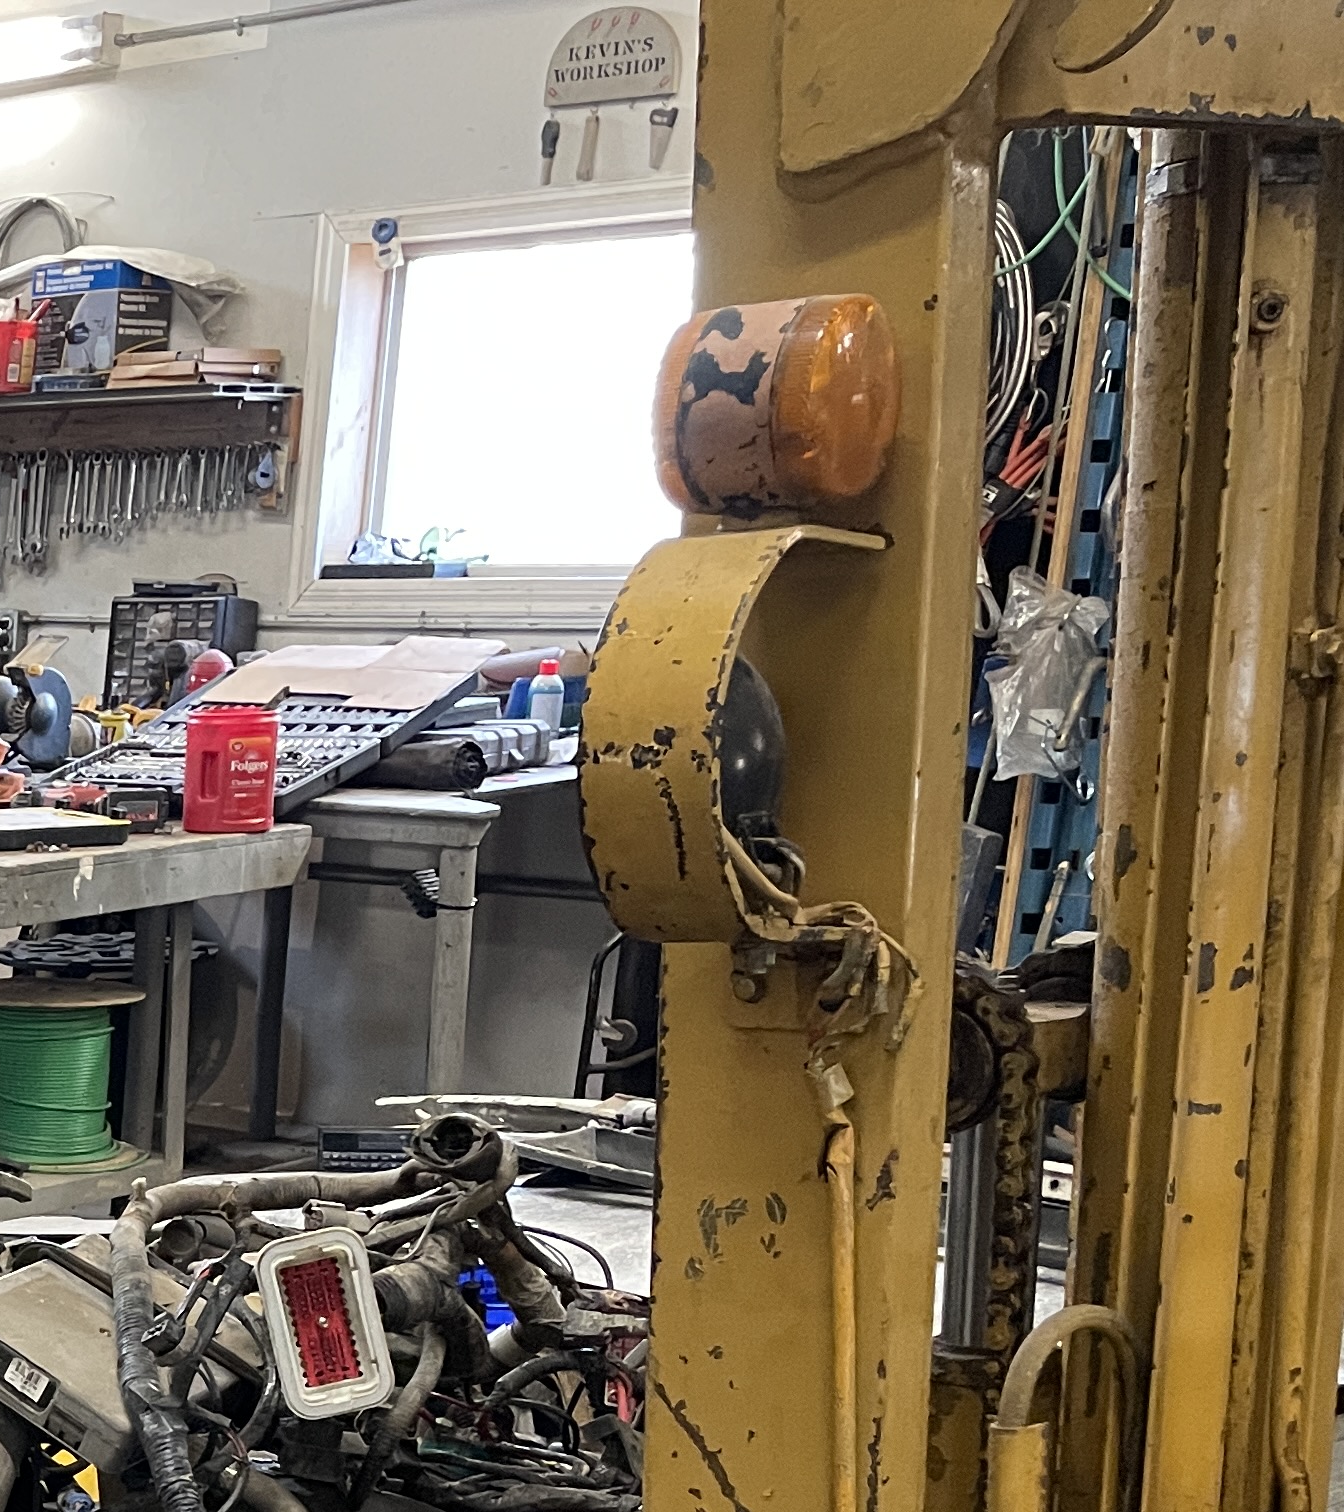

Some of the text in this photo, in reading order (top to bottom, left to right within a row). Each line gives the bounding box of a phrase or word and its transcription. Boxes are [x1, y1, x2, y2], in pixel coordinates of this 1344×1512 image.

[568, 36, 655, 62] KEVIN'S
[553, 56, 667, 83] WORKSHOP
[230, 759, 270, 774] Folgers
